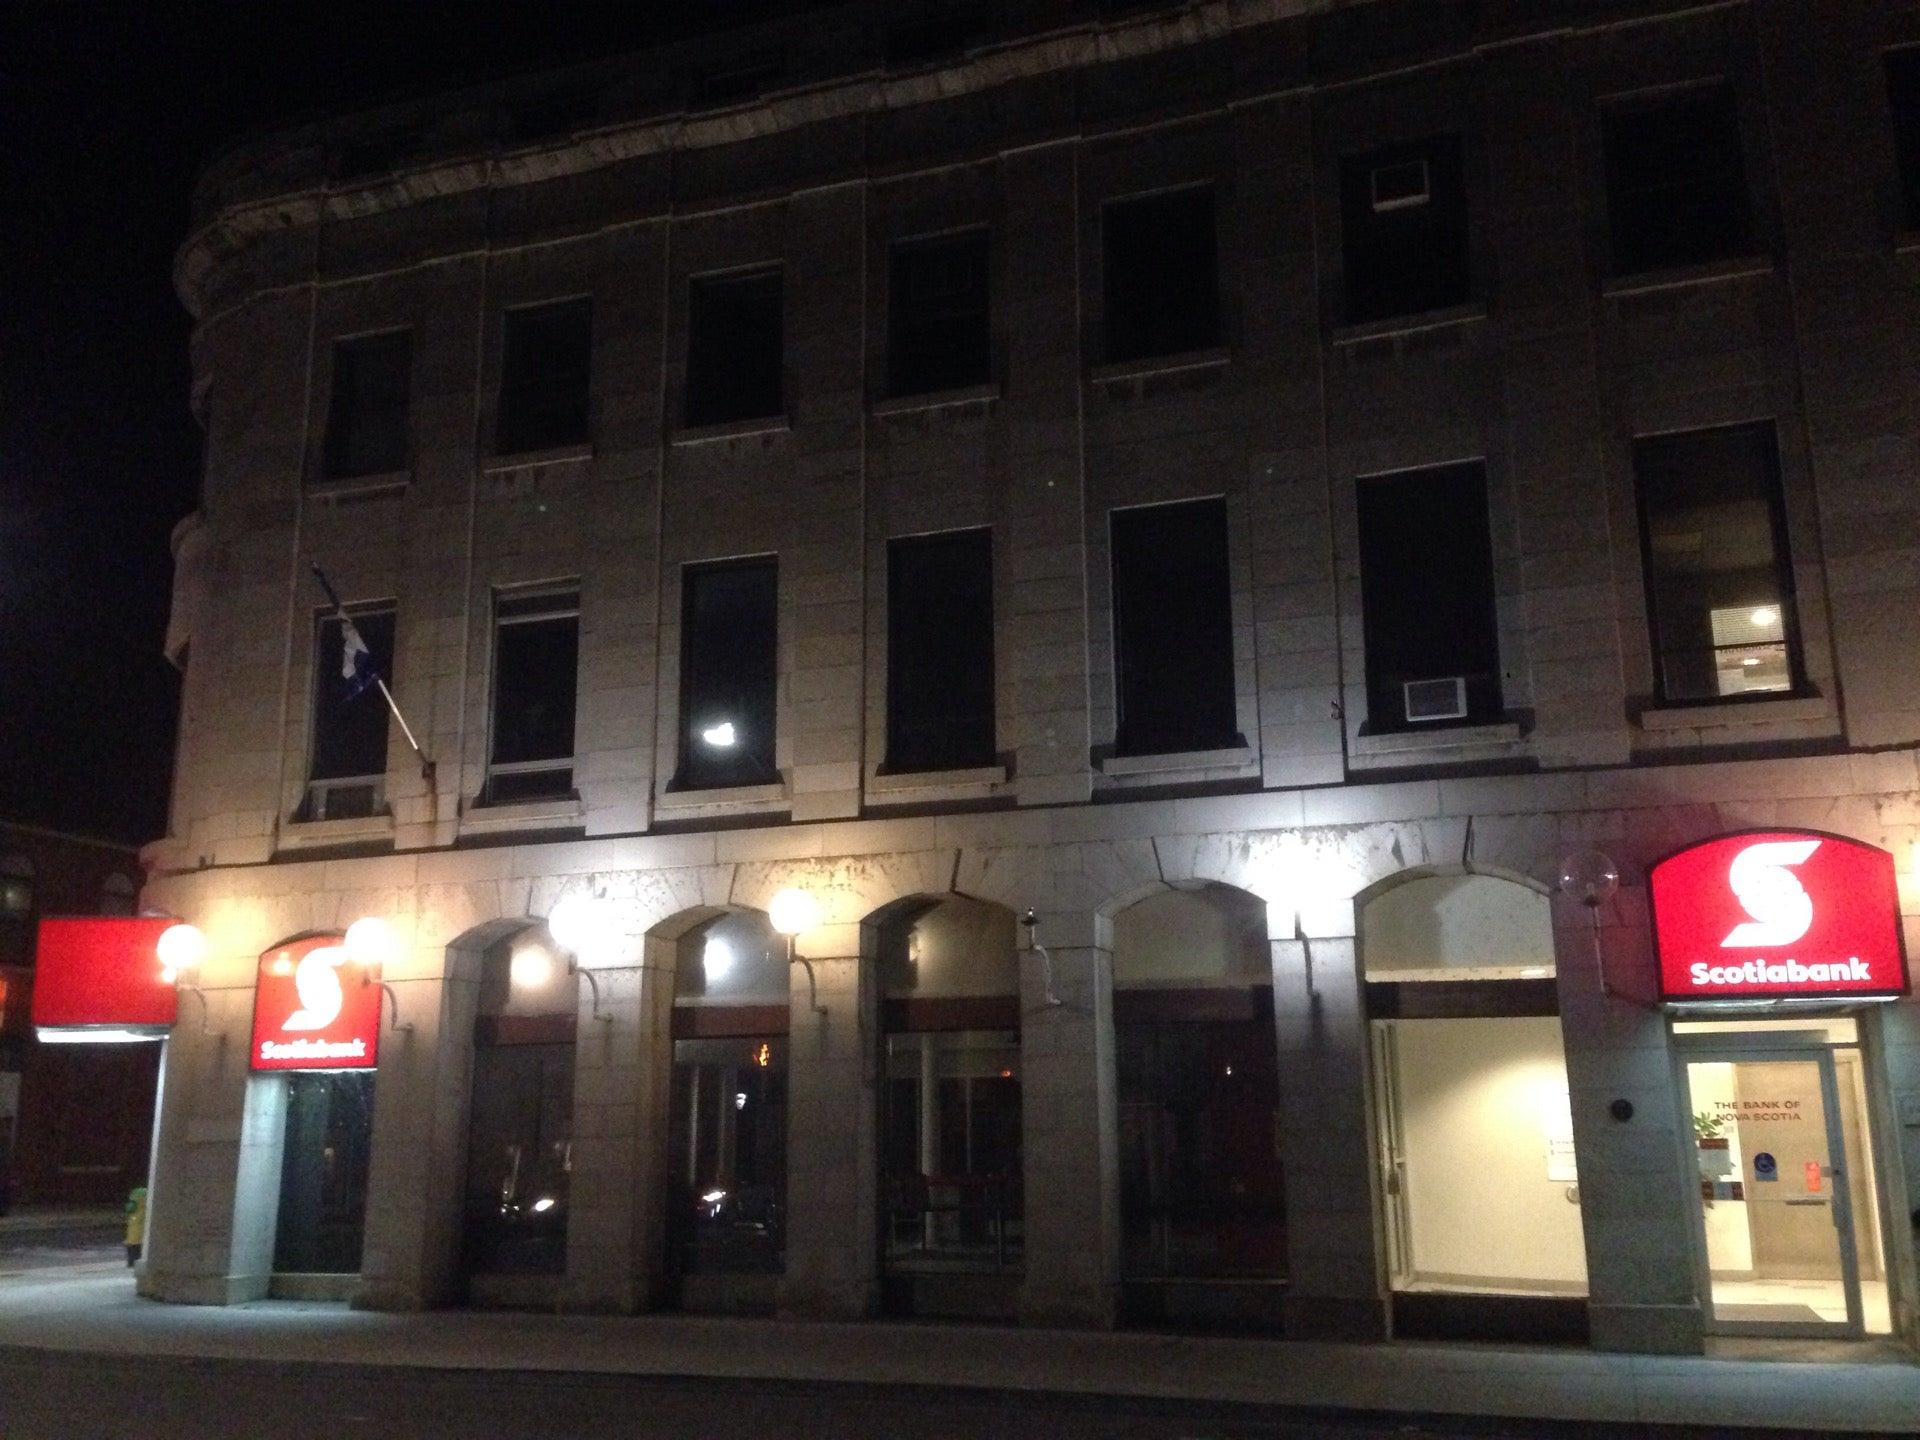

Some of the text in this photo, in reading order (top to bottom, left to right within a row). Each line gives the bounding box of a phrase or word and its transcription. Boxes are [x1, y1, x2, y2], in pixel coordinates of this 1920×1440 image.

[1690, 957, 1871, 985] Scotiabank
[1714, 1100, 1800, 1109] THE BANK OF
[1716, 1112, 1802, 1121] NOVA SCOTIA
